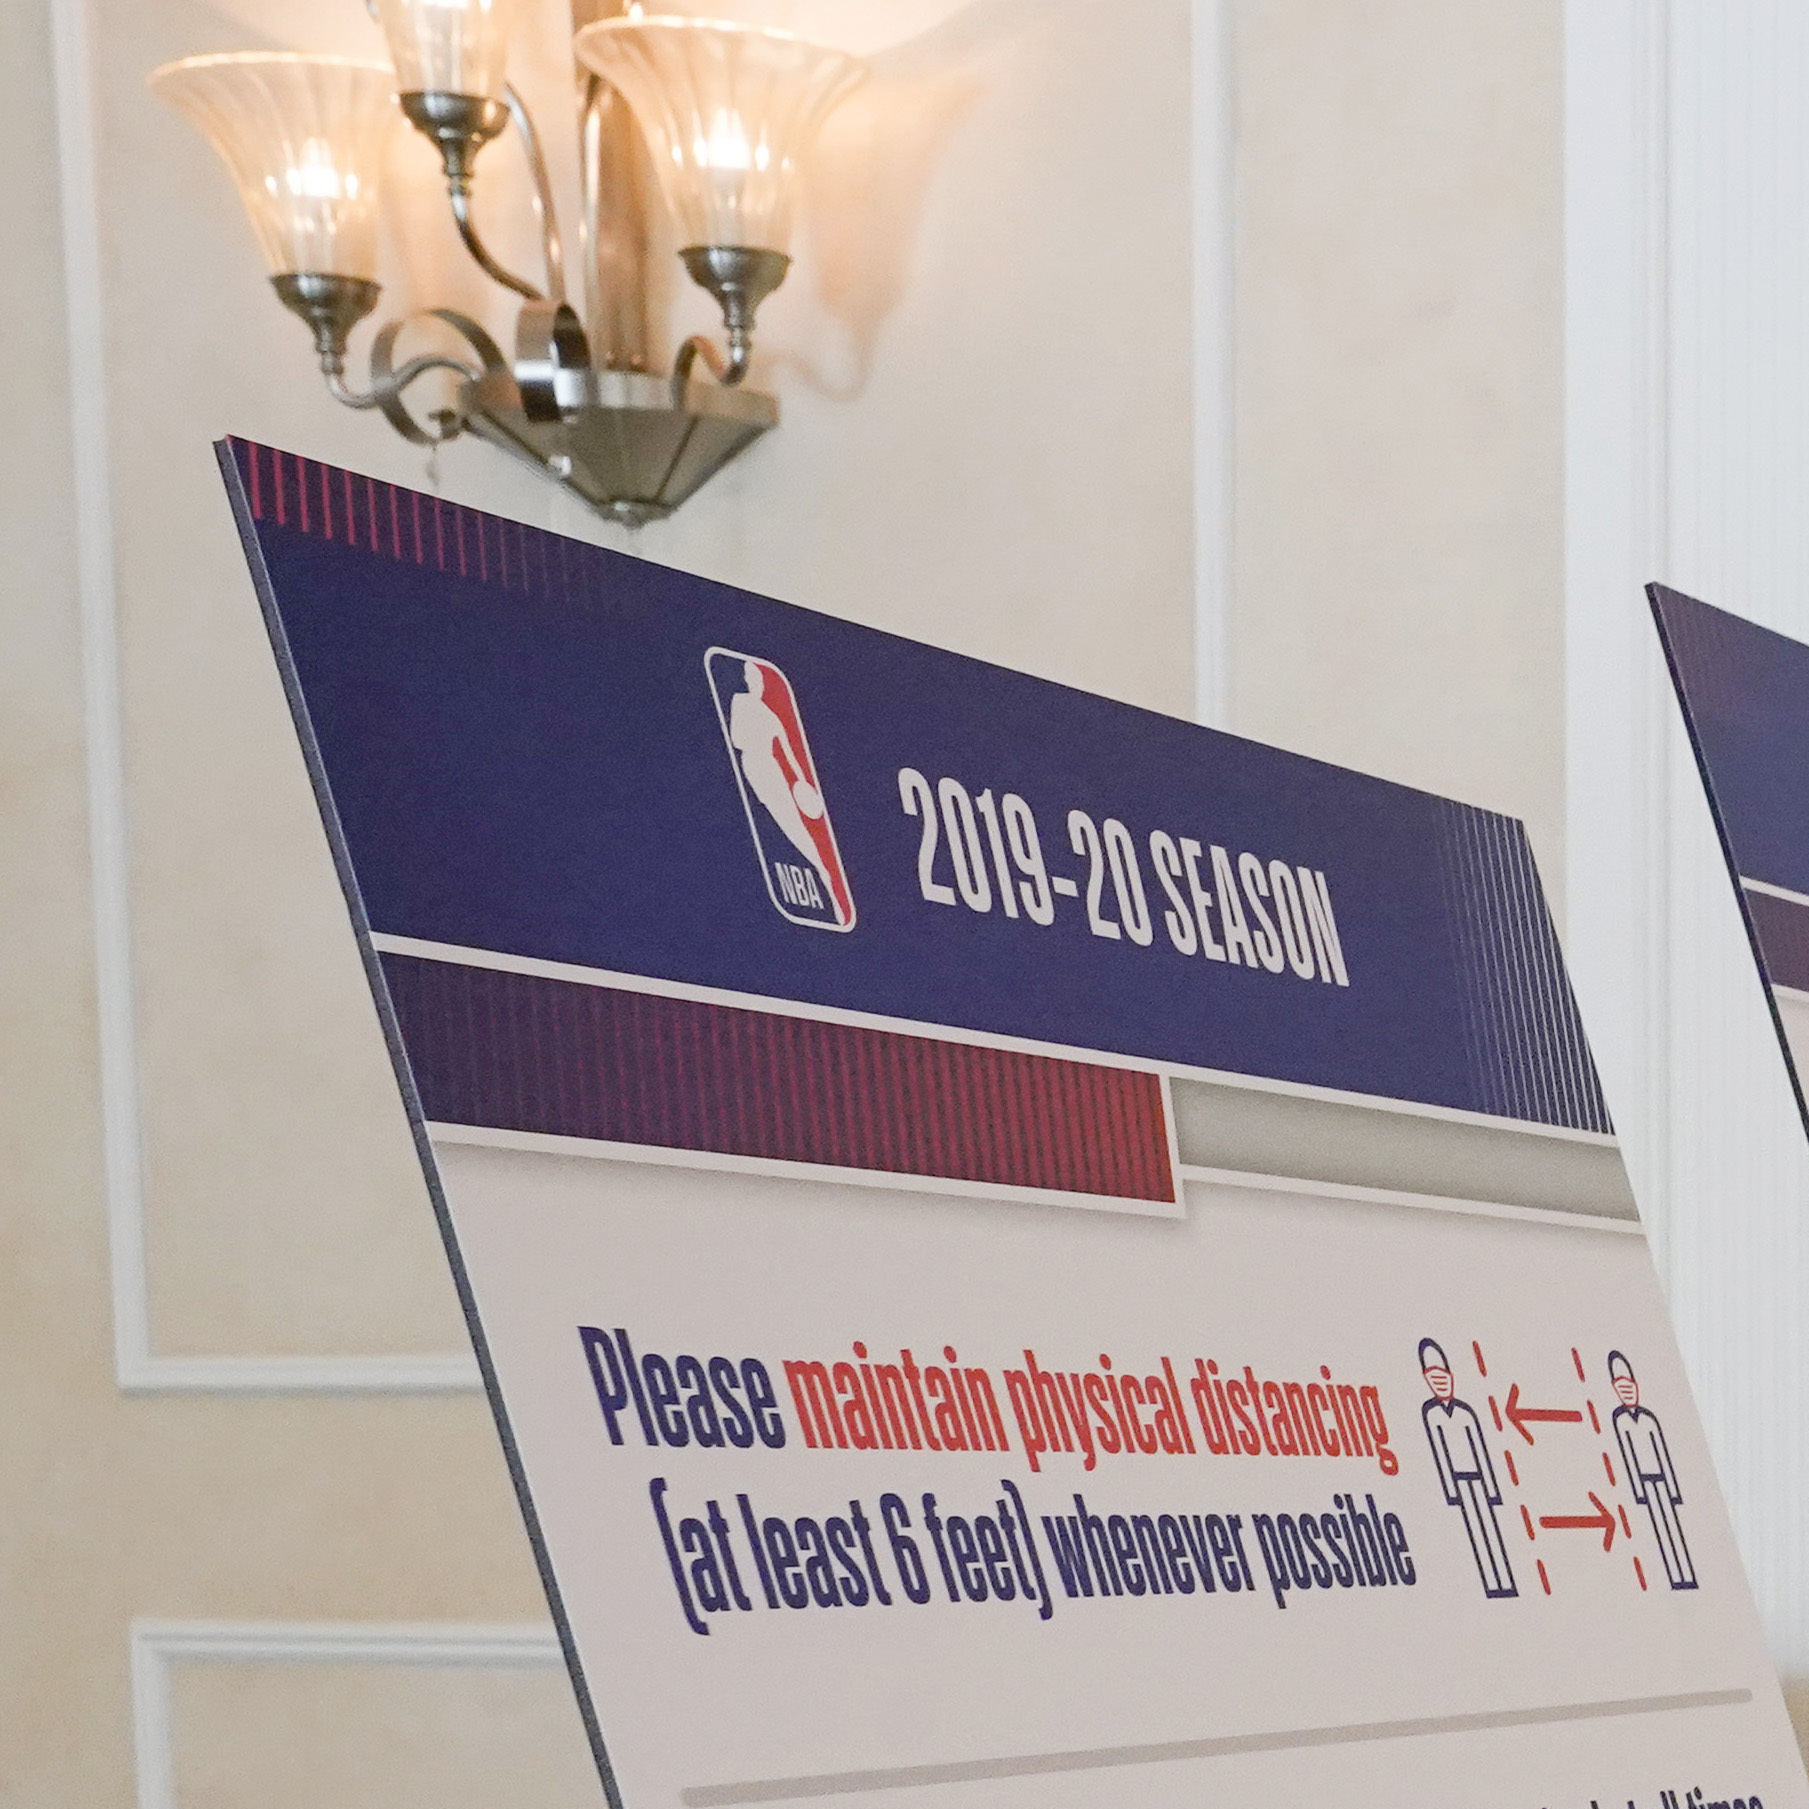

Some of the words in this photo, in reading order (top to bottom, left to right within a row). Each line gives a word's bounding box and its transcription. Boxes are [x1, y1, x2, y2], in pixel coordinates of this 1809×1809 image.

[774, 862, 824, 910] NBA
[898, 767, 1152, 946] 2019-20
[1149, 830, 1349, 988] SEASON
[577, 1326, 786, 1449] Please
[782, 1341, 1010, 1452] maintain
[1003, 1349, 1196, 1472] physical
[1190, 1358, 1399, 1475] distancing
[649, 1478, 753, 1635] (at
[736, 1494, 893, 1610] least
[880, 1493, 930, 1604] 6
[921, 1479, 1053, 1620] feet)
[1041, 1493, 1256, 1599] whenever
[1252, 1493, 1416, 1609] possible
